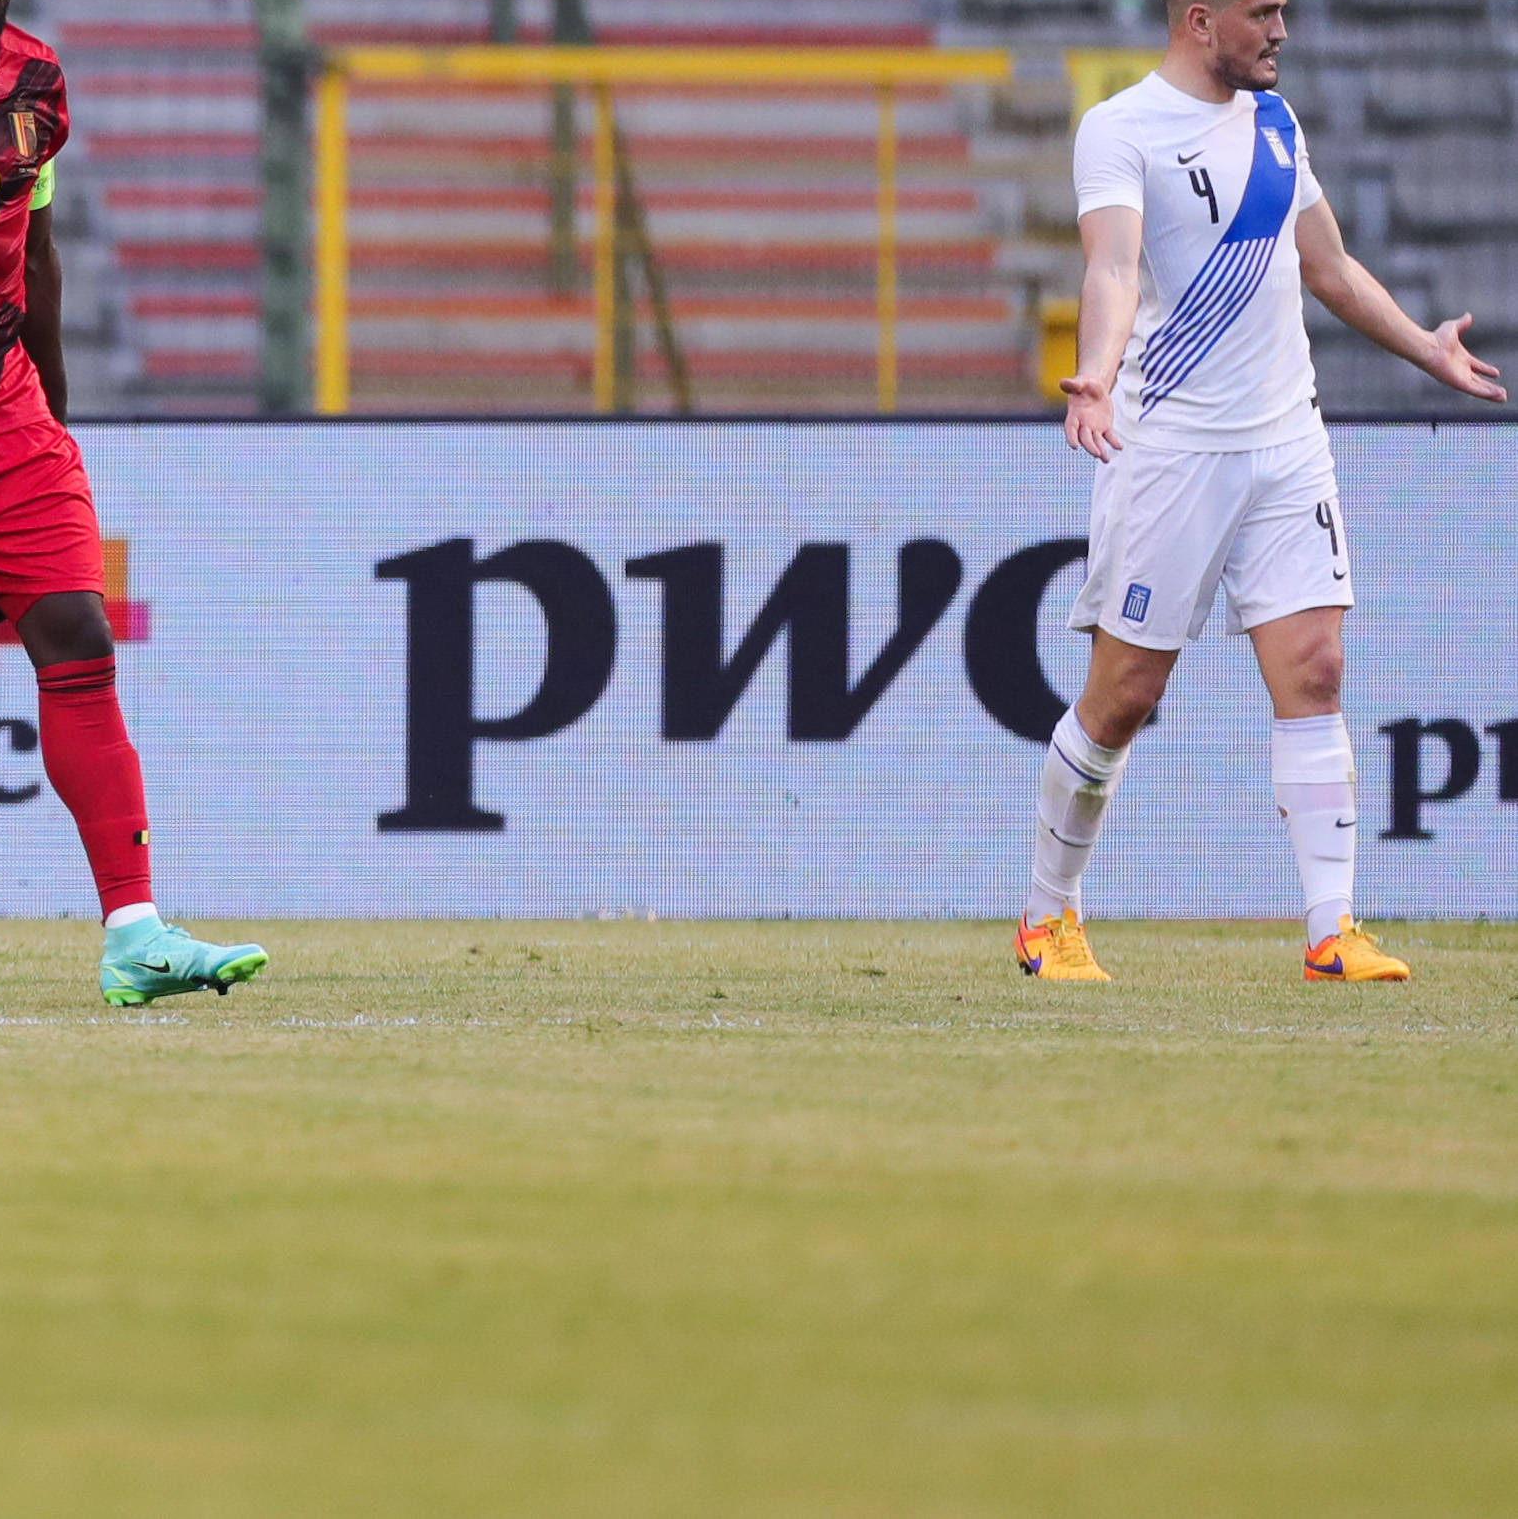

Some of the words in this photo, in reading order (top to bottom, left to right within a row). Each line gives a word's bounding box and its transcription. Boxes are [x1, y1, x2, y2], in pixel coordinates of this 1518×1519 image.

[1187, 166, 1220, 224] 4
[1315, 500, 1339, 557] 4
[373, 536, 1157, 833] pwc
